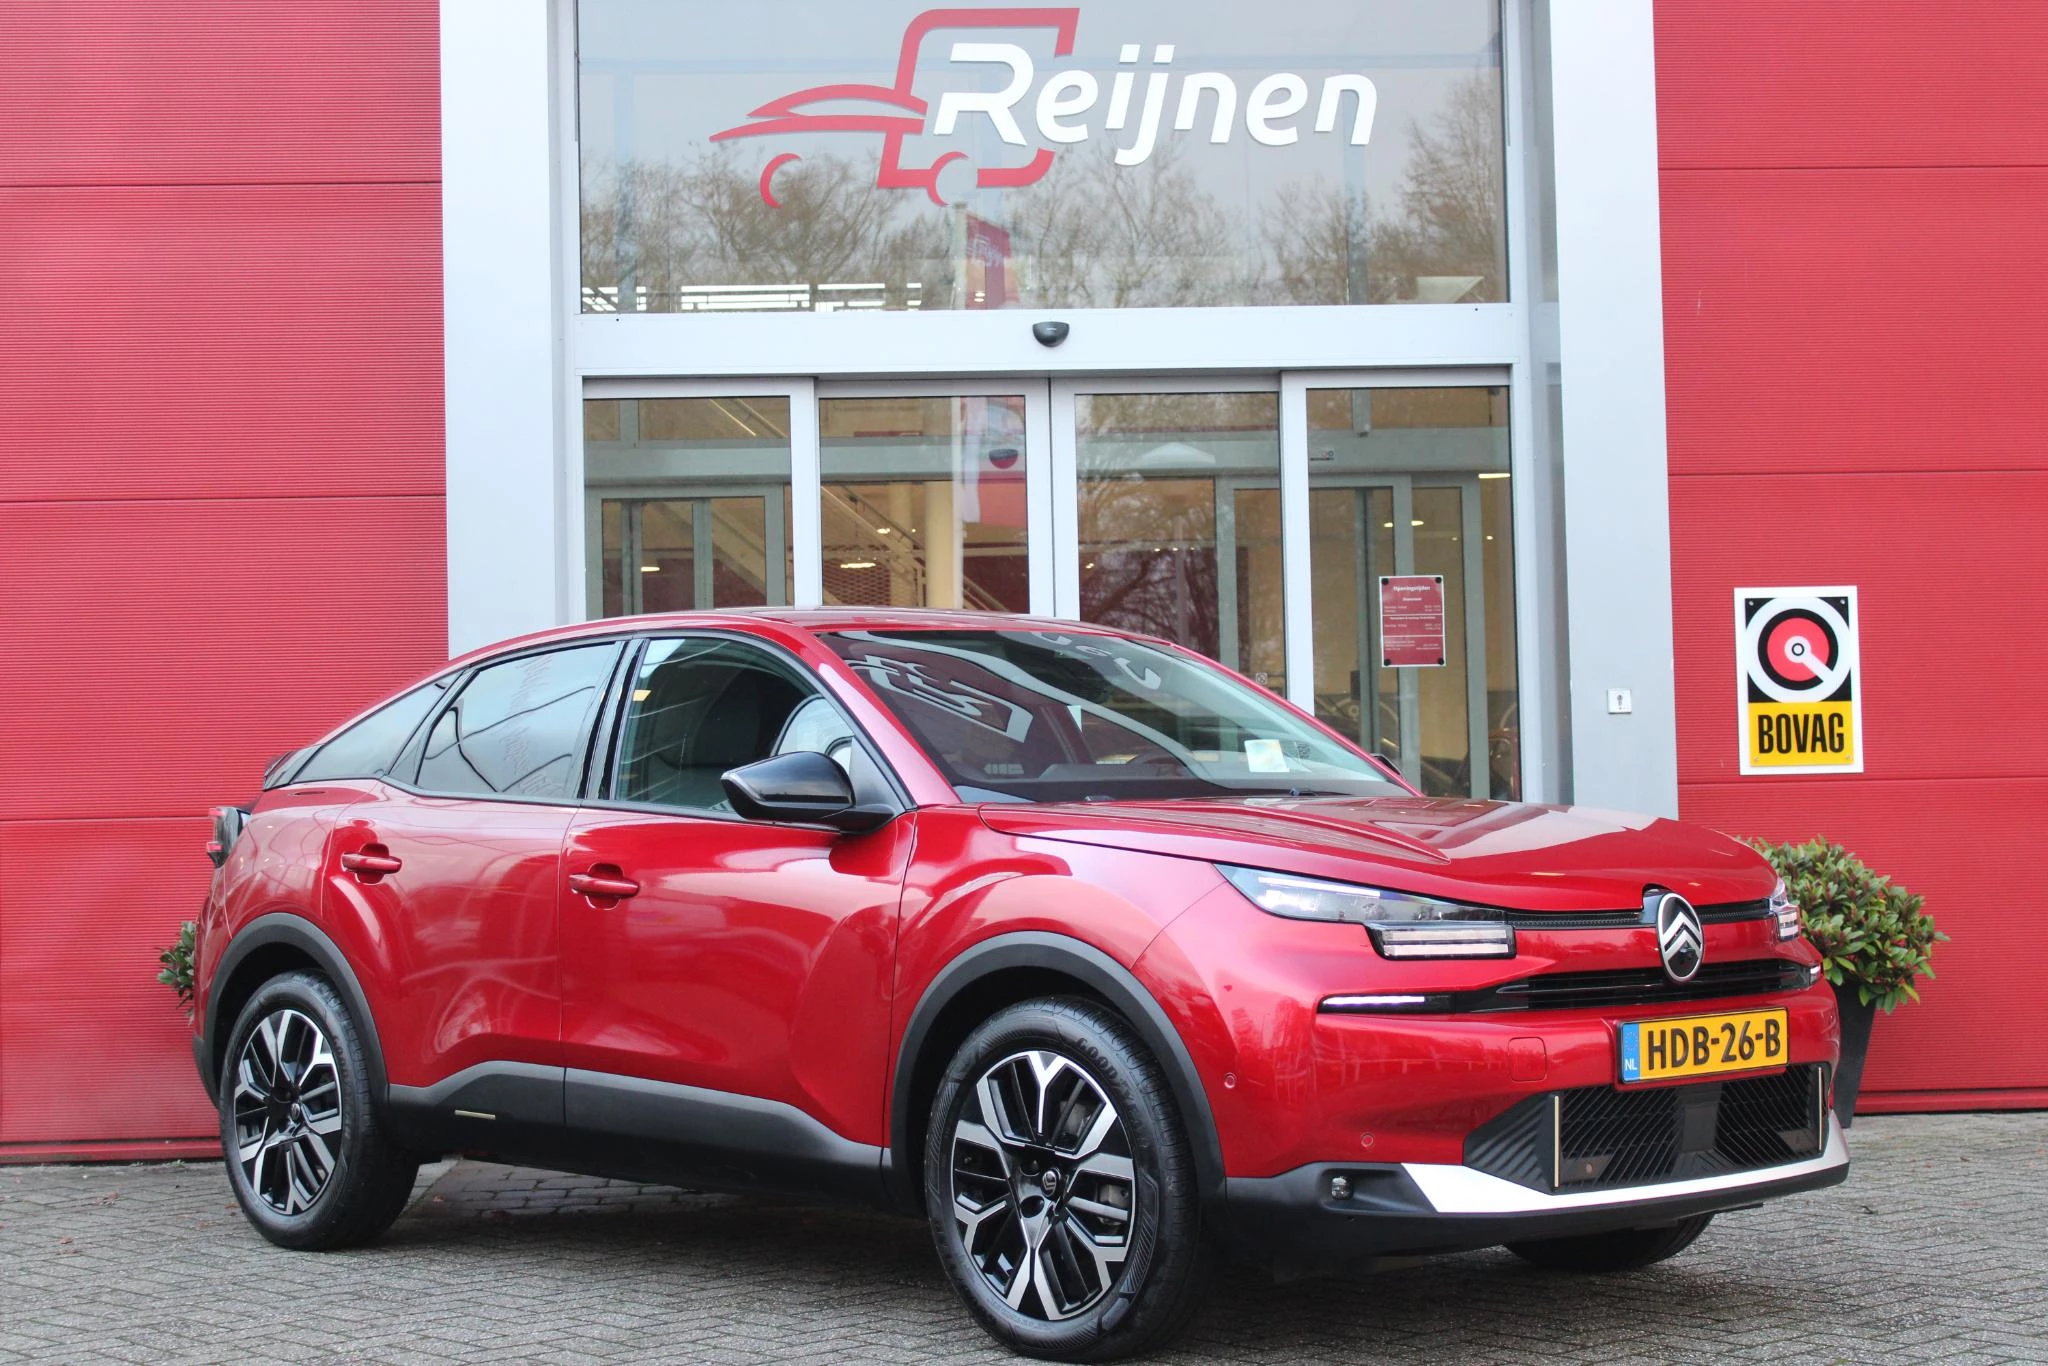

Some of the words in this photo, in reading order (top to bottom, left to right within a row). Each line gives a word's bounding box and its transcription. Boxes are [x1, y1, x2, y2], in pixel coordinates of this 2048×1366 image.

[932, 42, 1378, 167] Reijnen
[1757, 712, 1845, 754] BOVAG
[1624, 1058, 1638, 1071] NL
[1648, 1018, 1781, 1071] HDB-26-B
